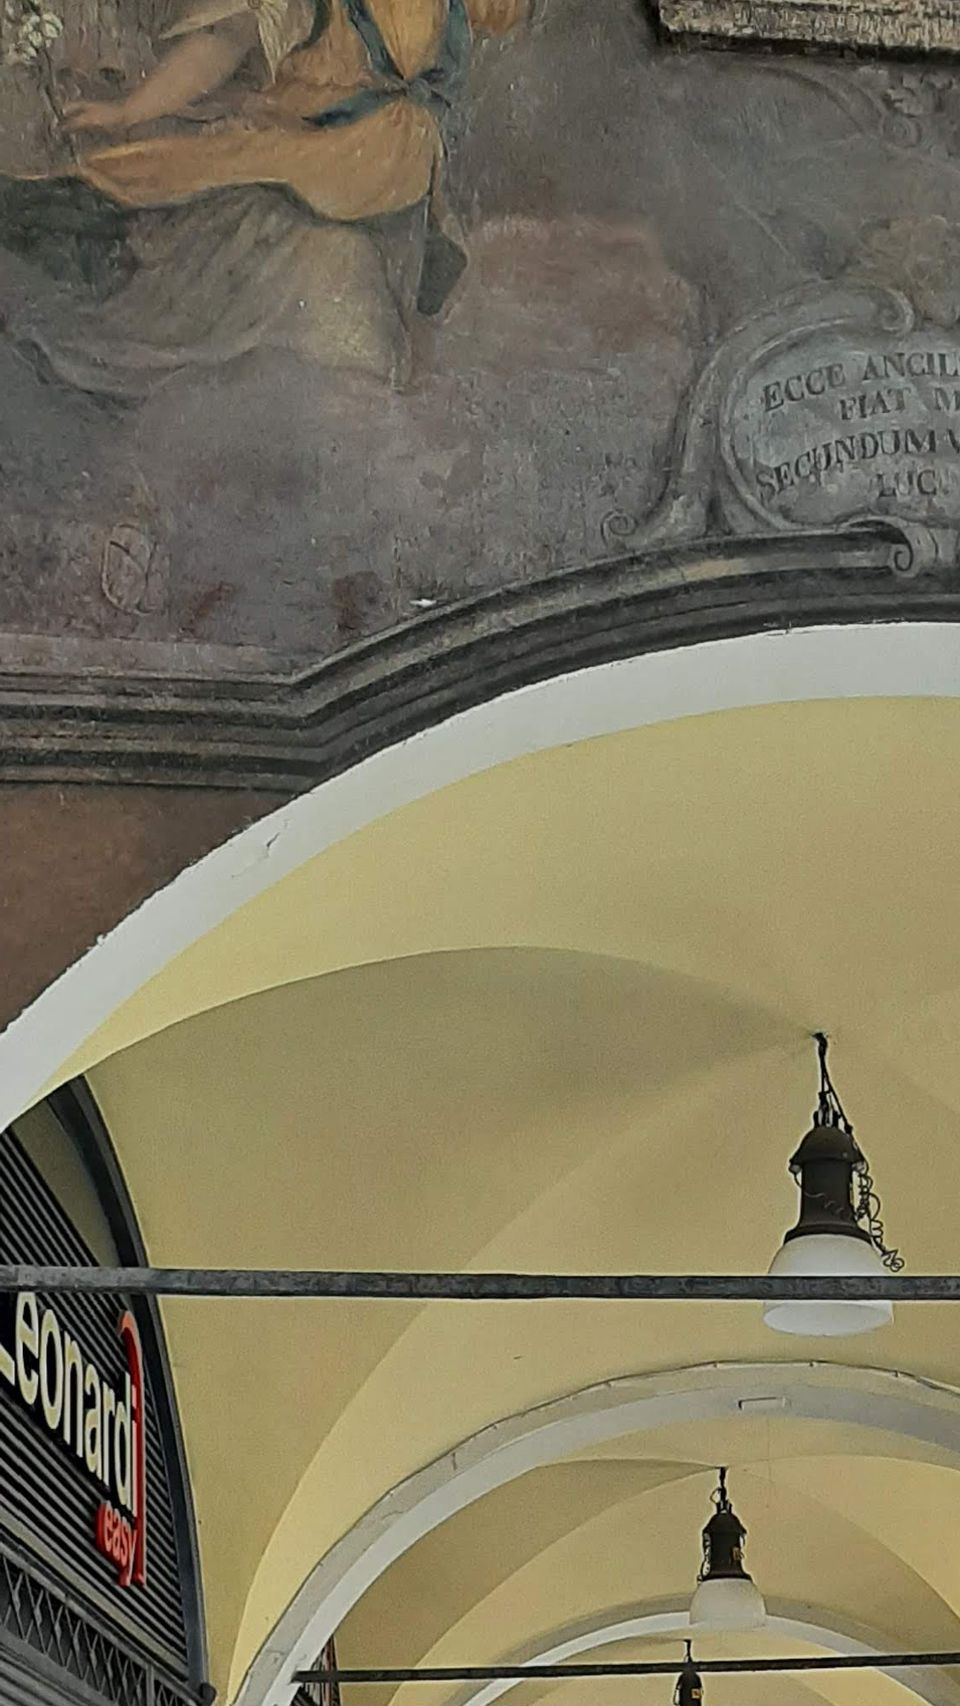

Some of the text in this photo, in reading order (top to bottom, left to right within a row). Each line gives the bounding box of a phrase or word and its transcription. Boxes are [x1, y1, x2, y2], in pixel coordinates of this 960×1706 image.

[763, 363, 846, 412] ECCE
[839, 386, 911, 420] FIAT
[756, 428, 937, 504] SECUNDUM
[103, 1501, 138, 1586] easy
